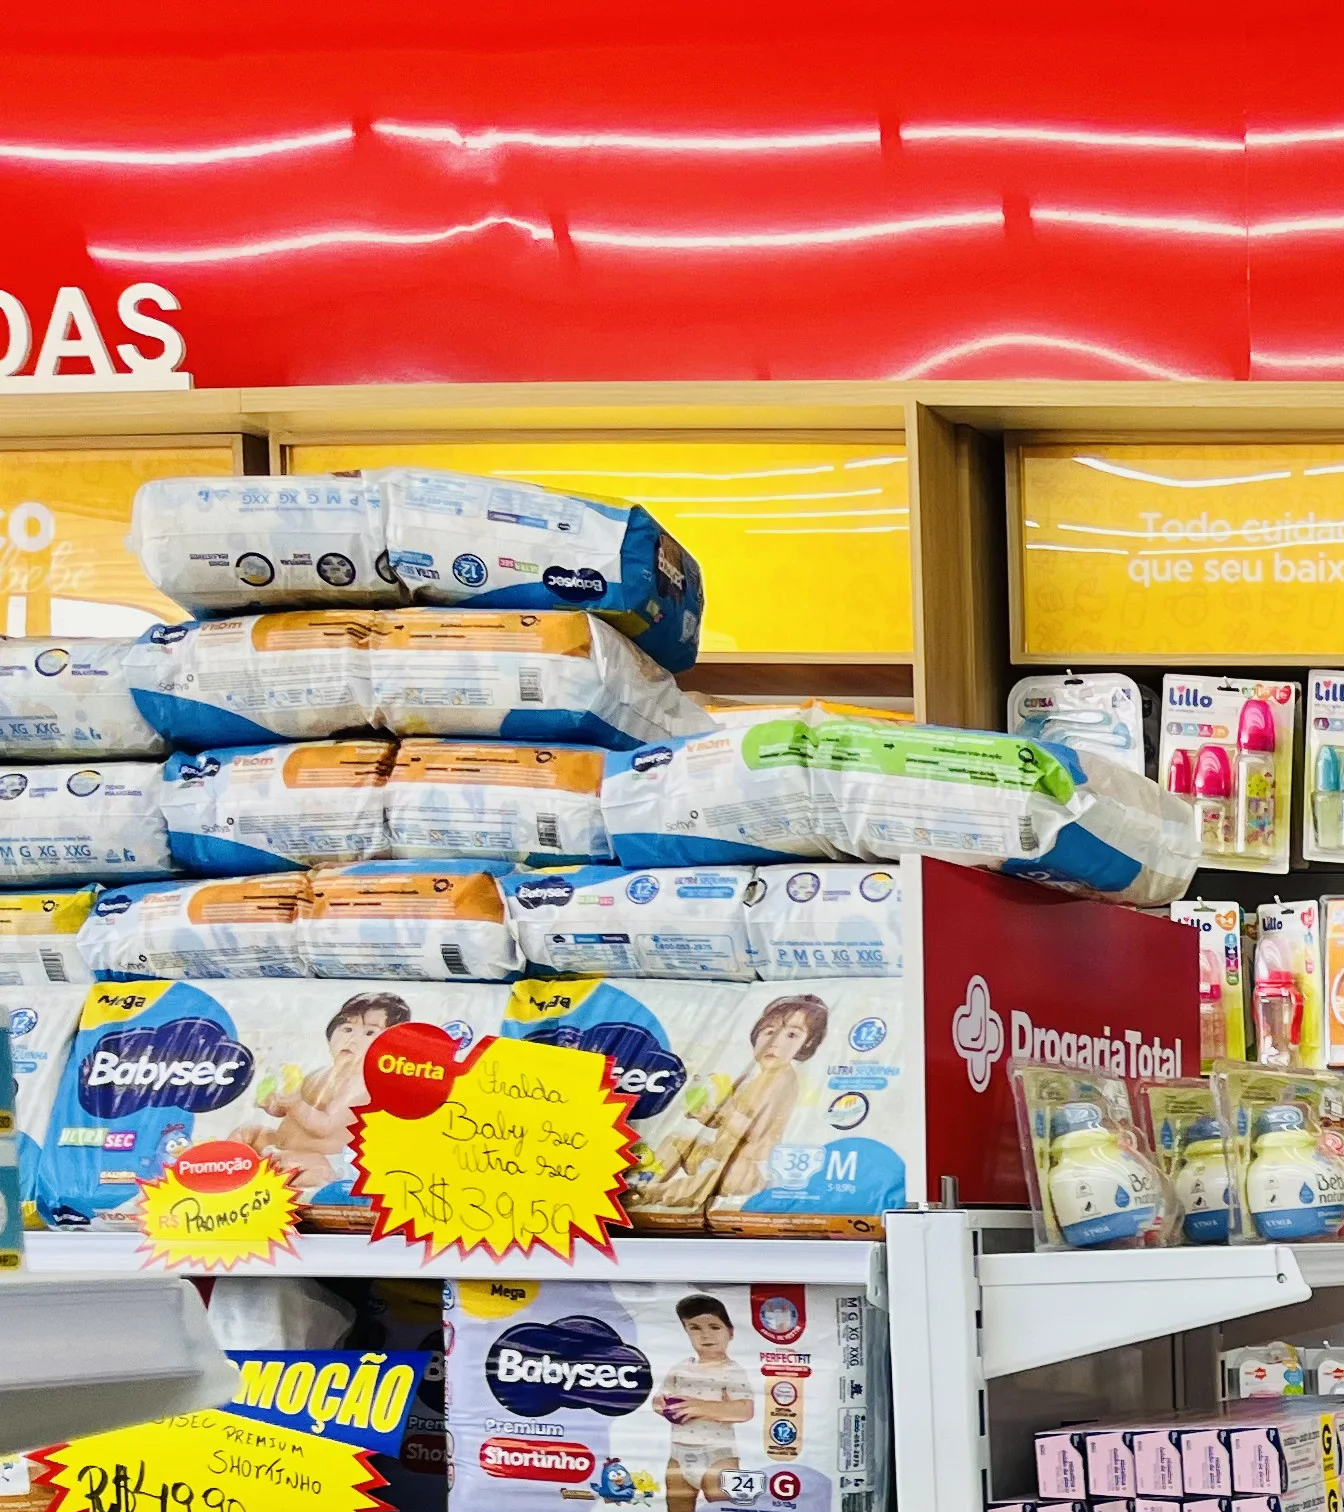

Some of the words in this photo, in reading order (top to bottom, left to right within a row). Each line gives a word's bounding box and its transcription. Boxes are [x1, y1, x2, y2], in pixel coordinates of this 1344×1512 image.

[1139, 512, 1234, 543] Todo
[547, 572, 605, 595] Babysec
[1128, 558, 1195, 588] que
[1203, 560, 1264, 583] seu
[1169, 685, 1213, 709] Lillo
[519, 886, 572, 900] Babysec
[832, 949, 849, 961] XG
[856, 949, 883, 961] XXG
[88, 1051, 237, 1091] Babysec
[378, 1054, 445, 1082] Oferta
[444, 1101, 527, 1151] Baby
[104, 1132, 136, 1150] SEC
[179, 1155, 253, 1177] Promoção
[785, 1153, 809, 1172] 38
[826, 1150, 857, 1180] M
[158, 1214, 180, 1229] R$
[491, 1284, 526, 1300] Mega
[497, 1349, 641, 1391] Babysec
[225, 1352, 414, 1434] MOÇÃO
[484, 1418, 565, 1438] Premium
[1322, 1424, 1332, 1455] G
[224, 1426, 304, 1457] PREMIUM
[484, 1446, 590, 1471] Shortinho
[735, 1476, 757, 1494] 24
[773, 1475, 793, 1497] G
